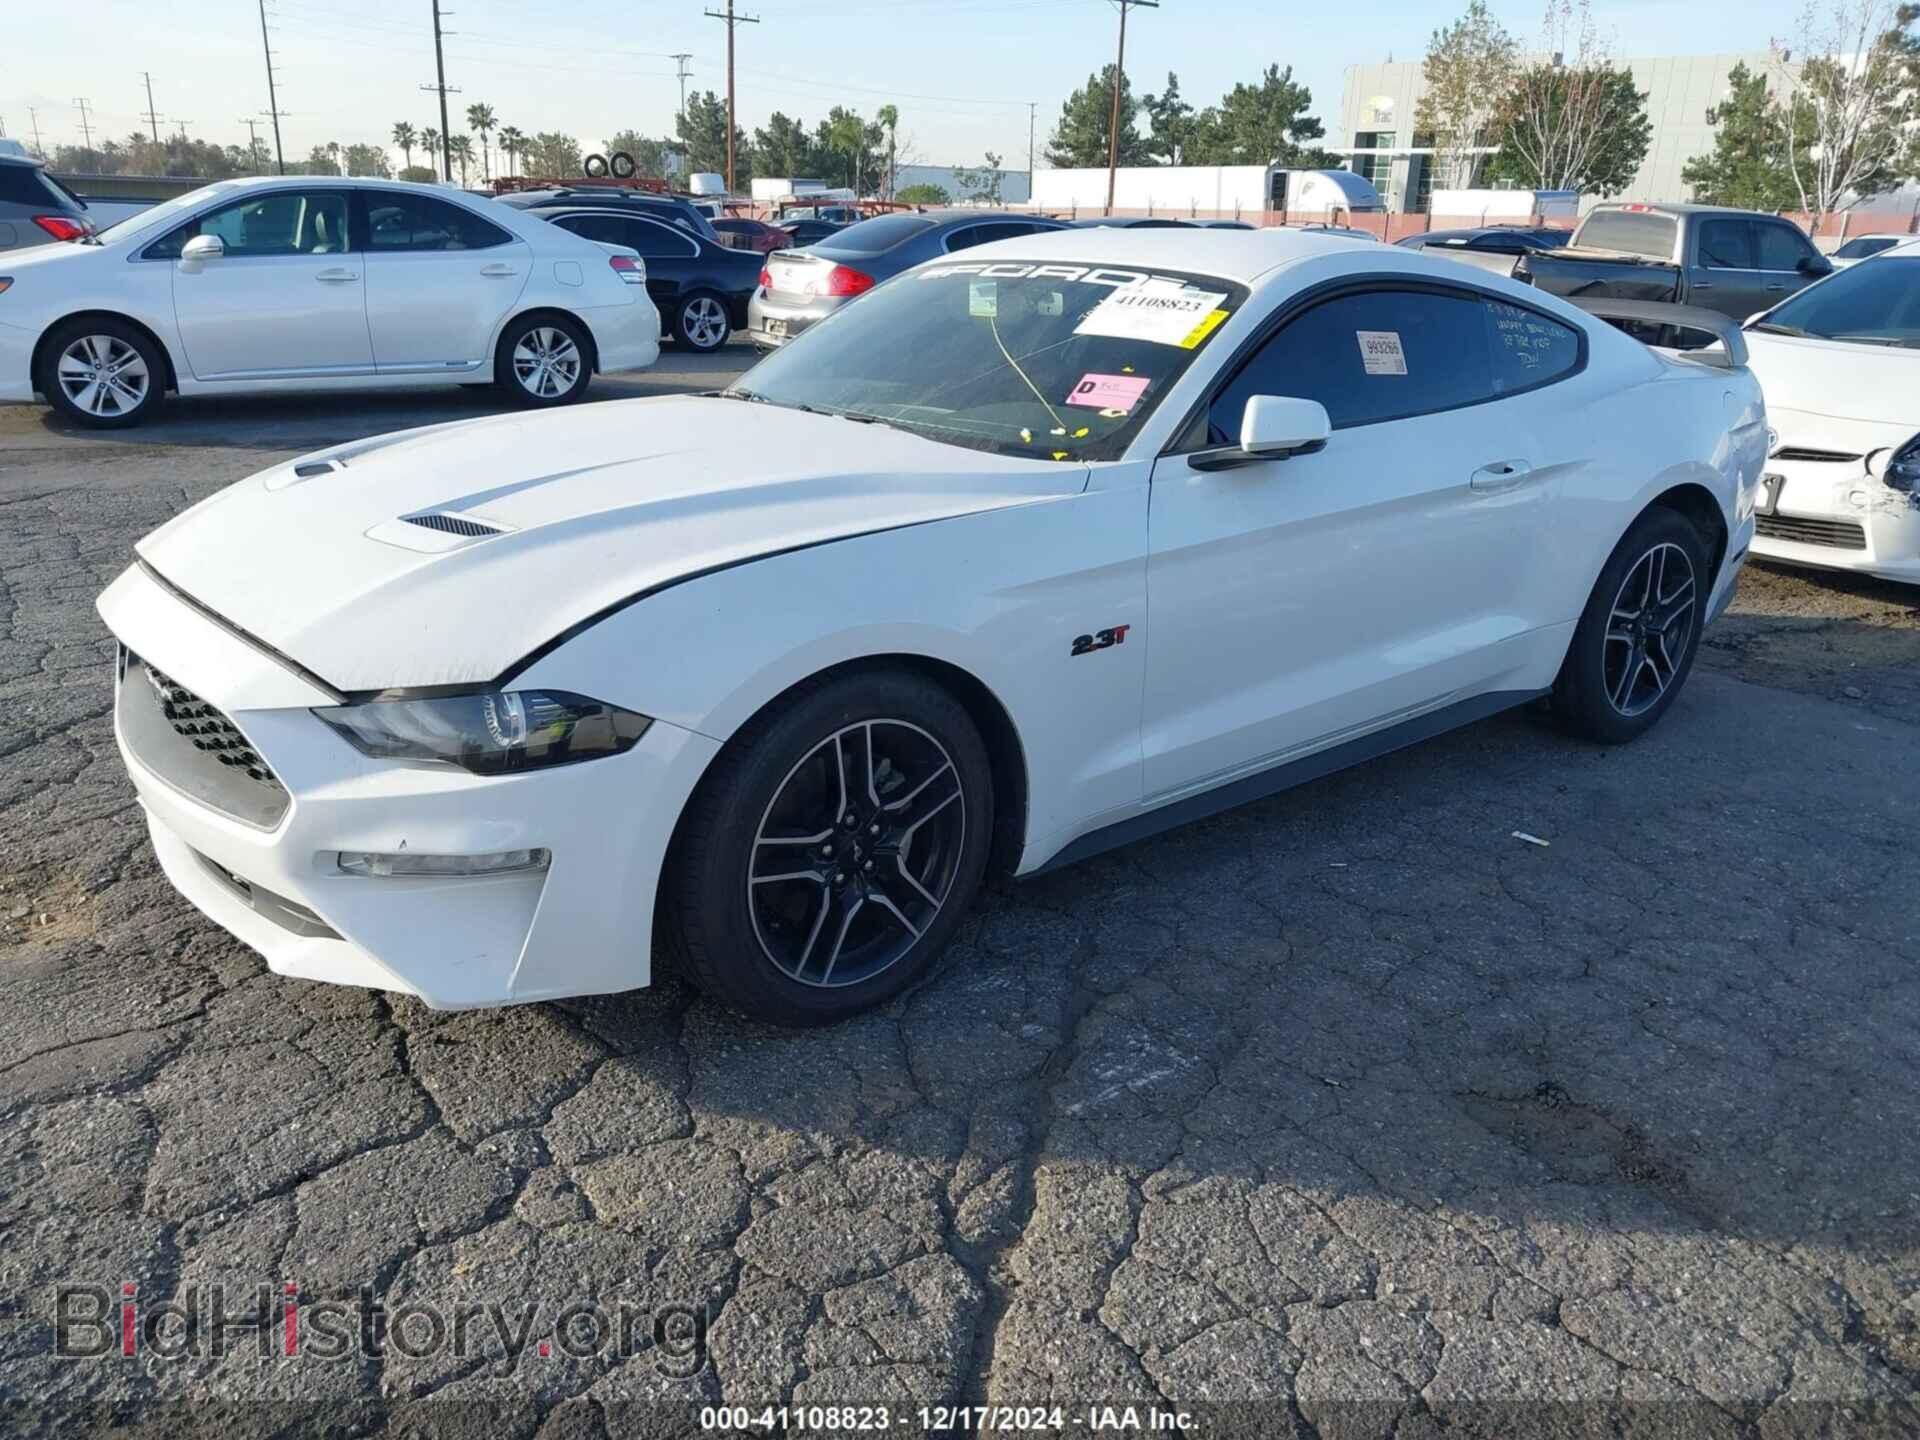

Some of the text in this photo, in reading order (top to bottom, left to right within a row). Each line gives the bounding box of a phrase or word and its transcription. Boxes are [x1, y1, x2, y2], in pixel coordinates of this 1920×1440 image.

[942, 264, 1149, 287] FORD
[1116, 294, 1201, 313] 41108823
[1077, 381, 1097, 394] D
[1070, 624, 1130, 656] 2.3T
